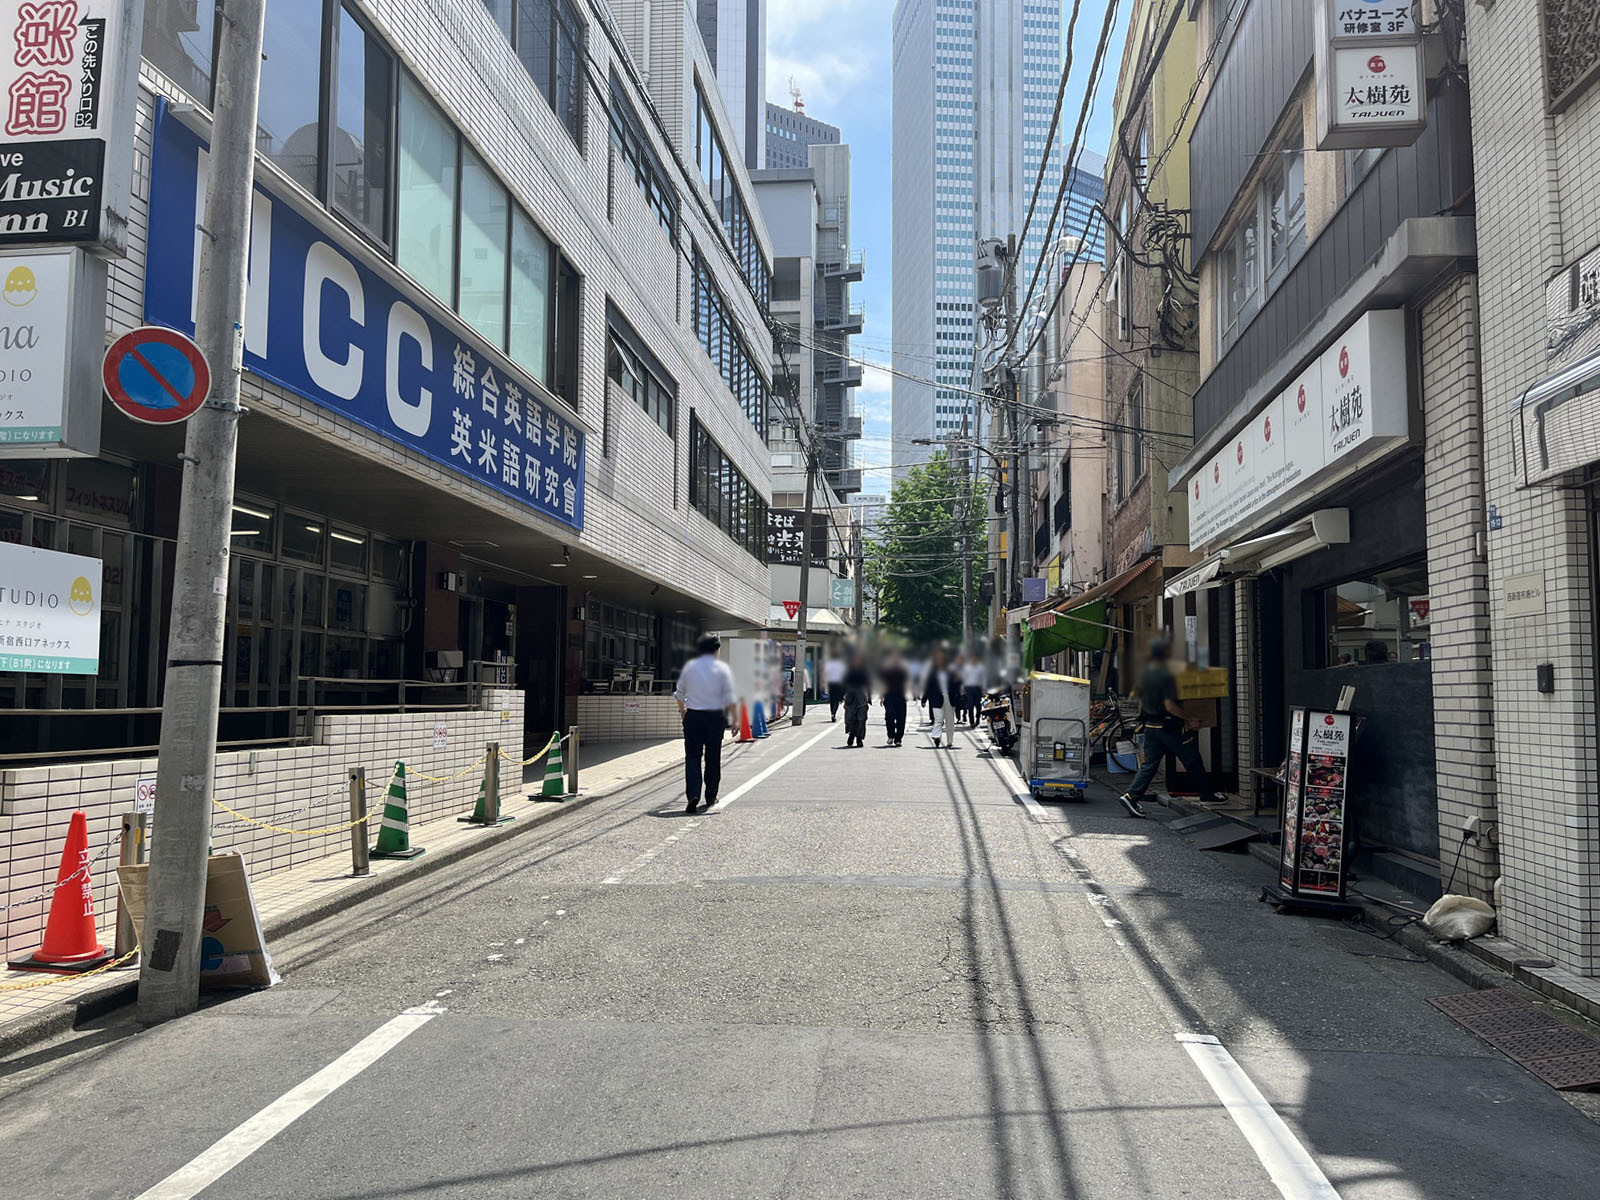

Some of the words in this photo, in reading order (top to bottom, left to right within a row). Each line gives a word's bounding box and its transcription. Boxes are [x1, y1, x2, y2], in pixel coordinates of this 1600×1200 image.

[1339, 7, 1408, 21] パナユーズ
[1344, 22, 1382, 33] 研修室
[1387, 21, 1405, 32] 3F
[81, 24, 100, 111] この先入り口
[76, 113, 92, 127] B2
[1352, 110, 1405, 118] TAIJUEN
[62, 209, 89, 228] B1
[452, 342, 577, 471] 綜合英語学院
[1333, 428, 1361, 454] TAIJUEN
[79, 847, 94, 917] 立入禁止
